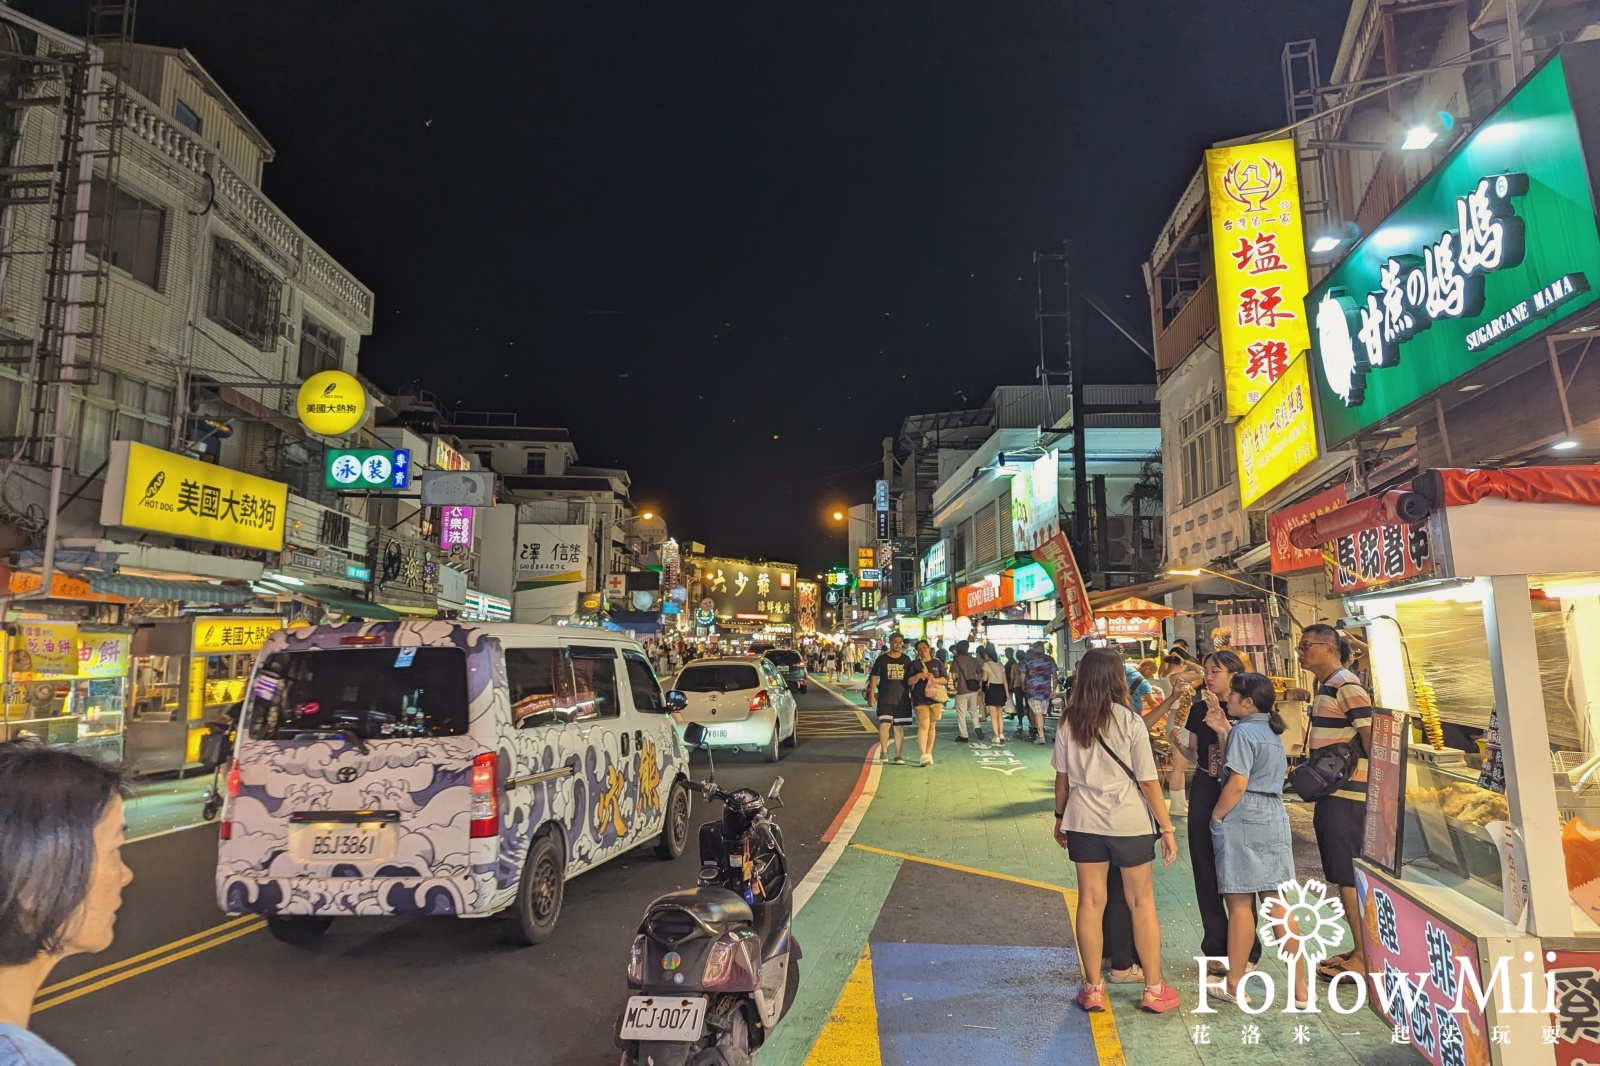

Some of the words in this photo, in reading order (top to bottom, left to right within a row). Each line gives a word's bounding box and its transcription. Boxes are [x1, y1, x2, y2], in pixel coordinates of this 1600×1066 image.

[1466, 301, 1529, 351] SUGARCANE
[1533, 276, 1574, 312] MAMA
[305, 403, 357, 414] 美國大熱狗
[336, 459, 385, 480] 泳裝
[395, 453, 407, 486] 專賣
[144, 499, 159, 509] HOT
[160, 503, 174, 513] DOG
[177, 478, 276, 531] 美國大熱狗
[711, 569, 771, 598] 六少爺
